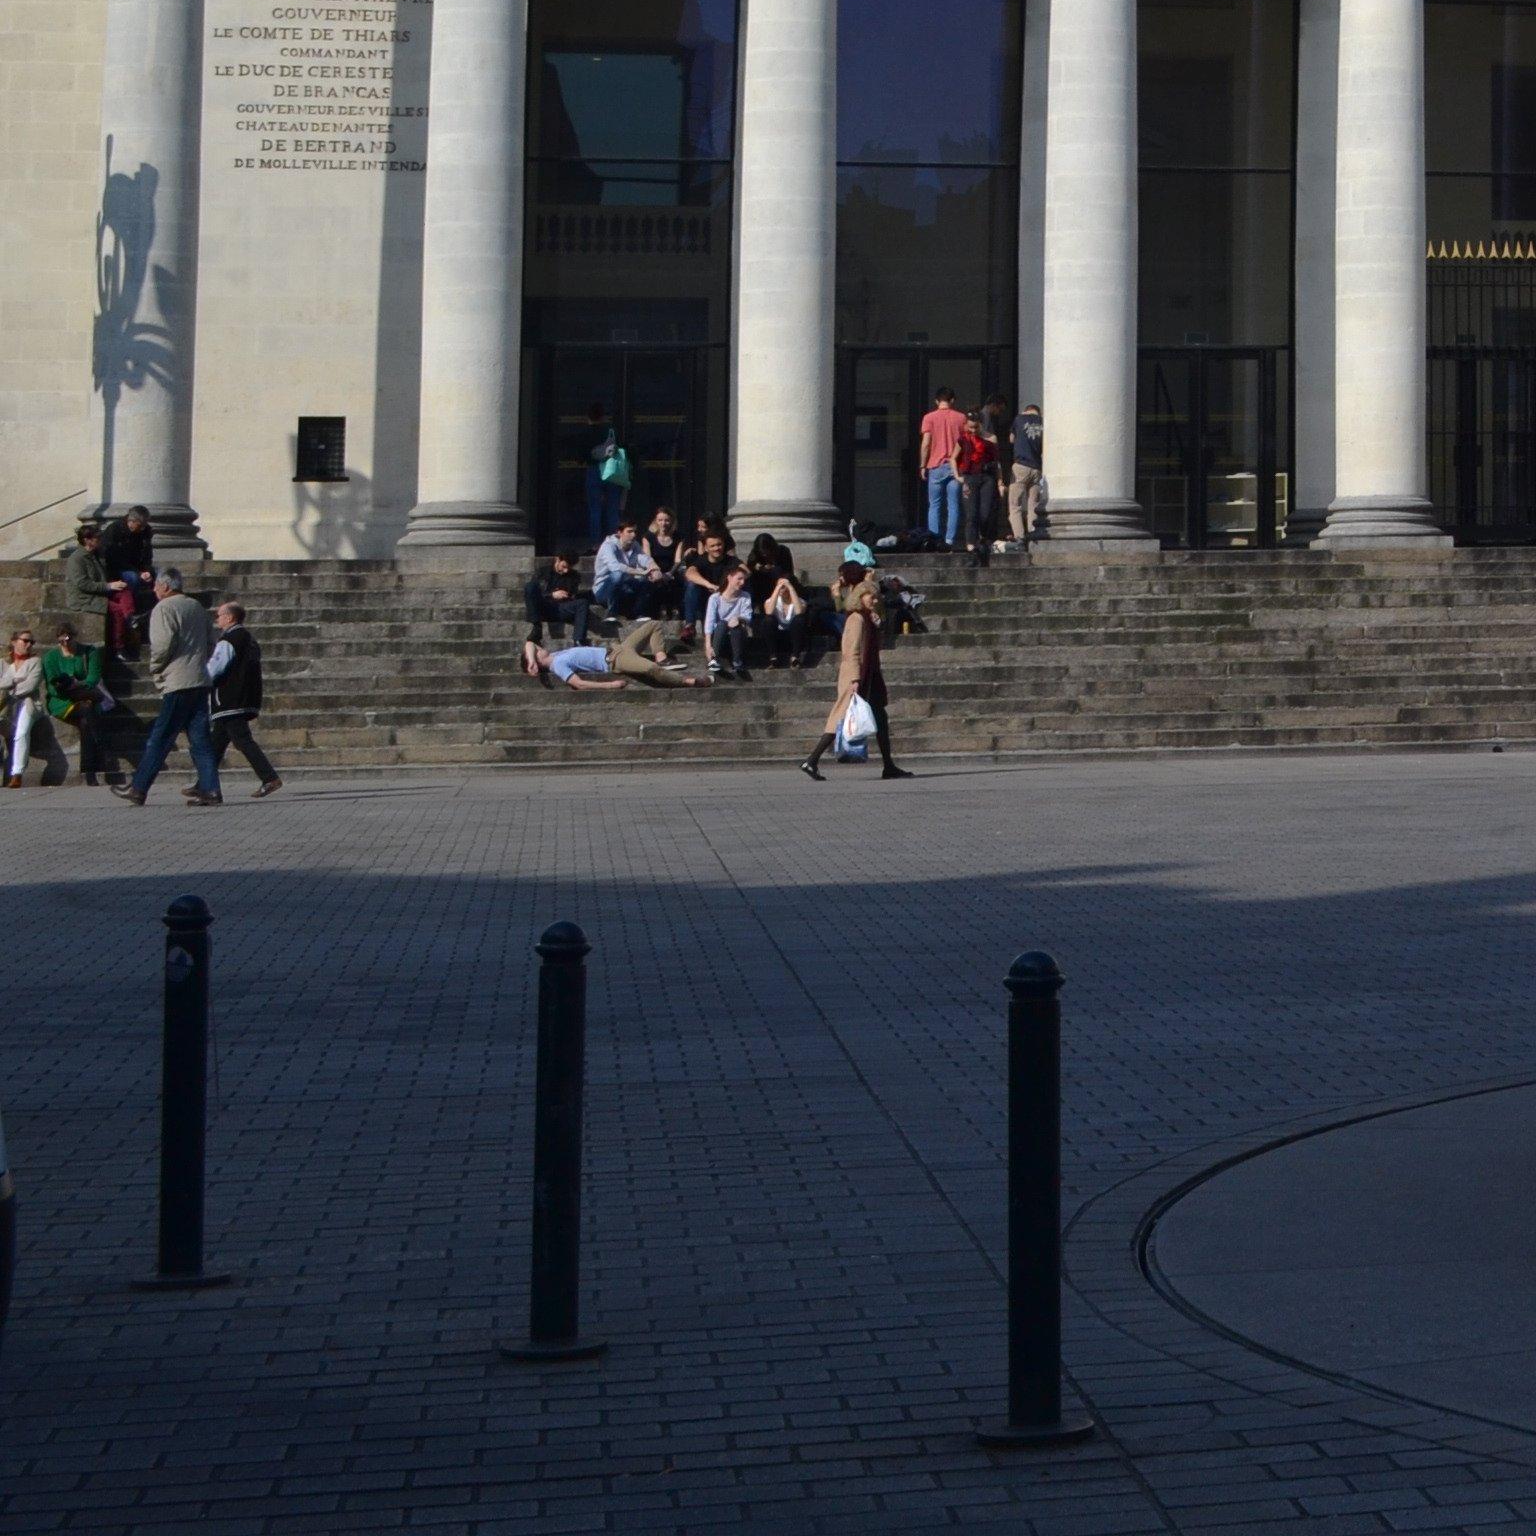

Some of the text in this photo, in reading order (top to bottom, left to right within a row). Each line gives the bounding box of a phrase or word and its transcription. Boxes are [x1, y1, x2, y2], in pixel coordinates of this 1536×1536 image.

[272, 7, 400, 22] GOUVERNEUR
[213, 27, 411, 43] LE COMTE DE THIARS
[280, 47, 389, 60] COMMANDANT
[215, 64, 395, 80] LE DUC DE CERESTE
[274, 85, 391, 99] DE BRANCAS
[237, 103, 423, 118] GOUVERNEUR DES VILLES
[235, 120, 394, 134] CHATEAU DE NANTES
[261, 139, 397, 154] DE BERTRAND
[234, 158, 255, 169] DE
[259, 158, 358, 170] MOLLEVILLE
